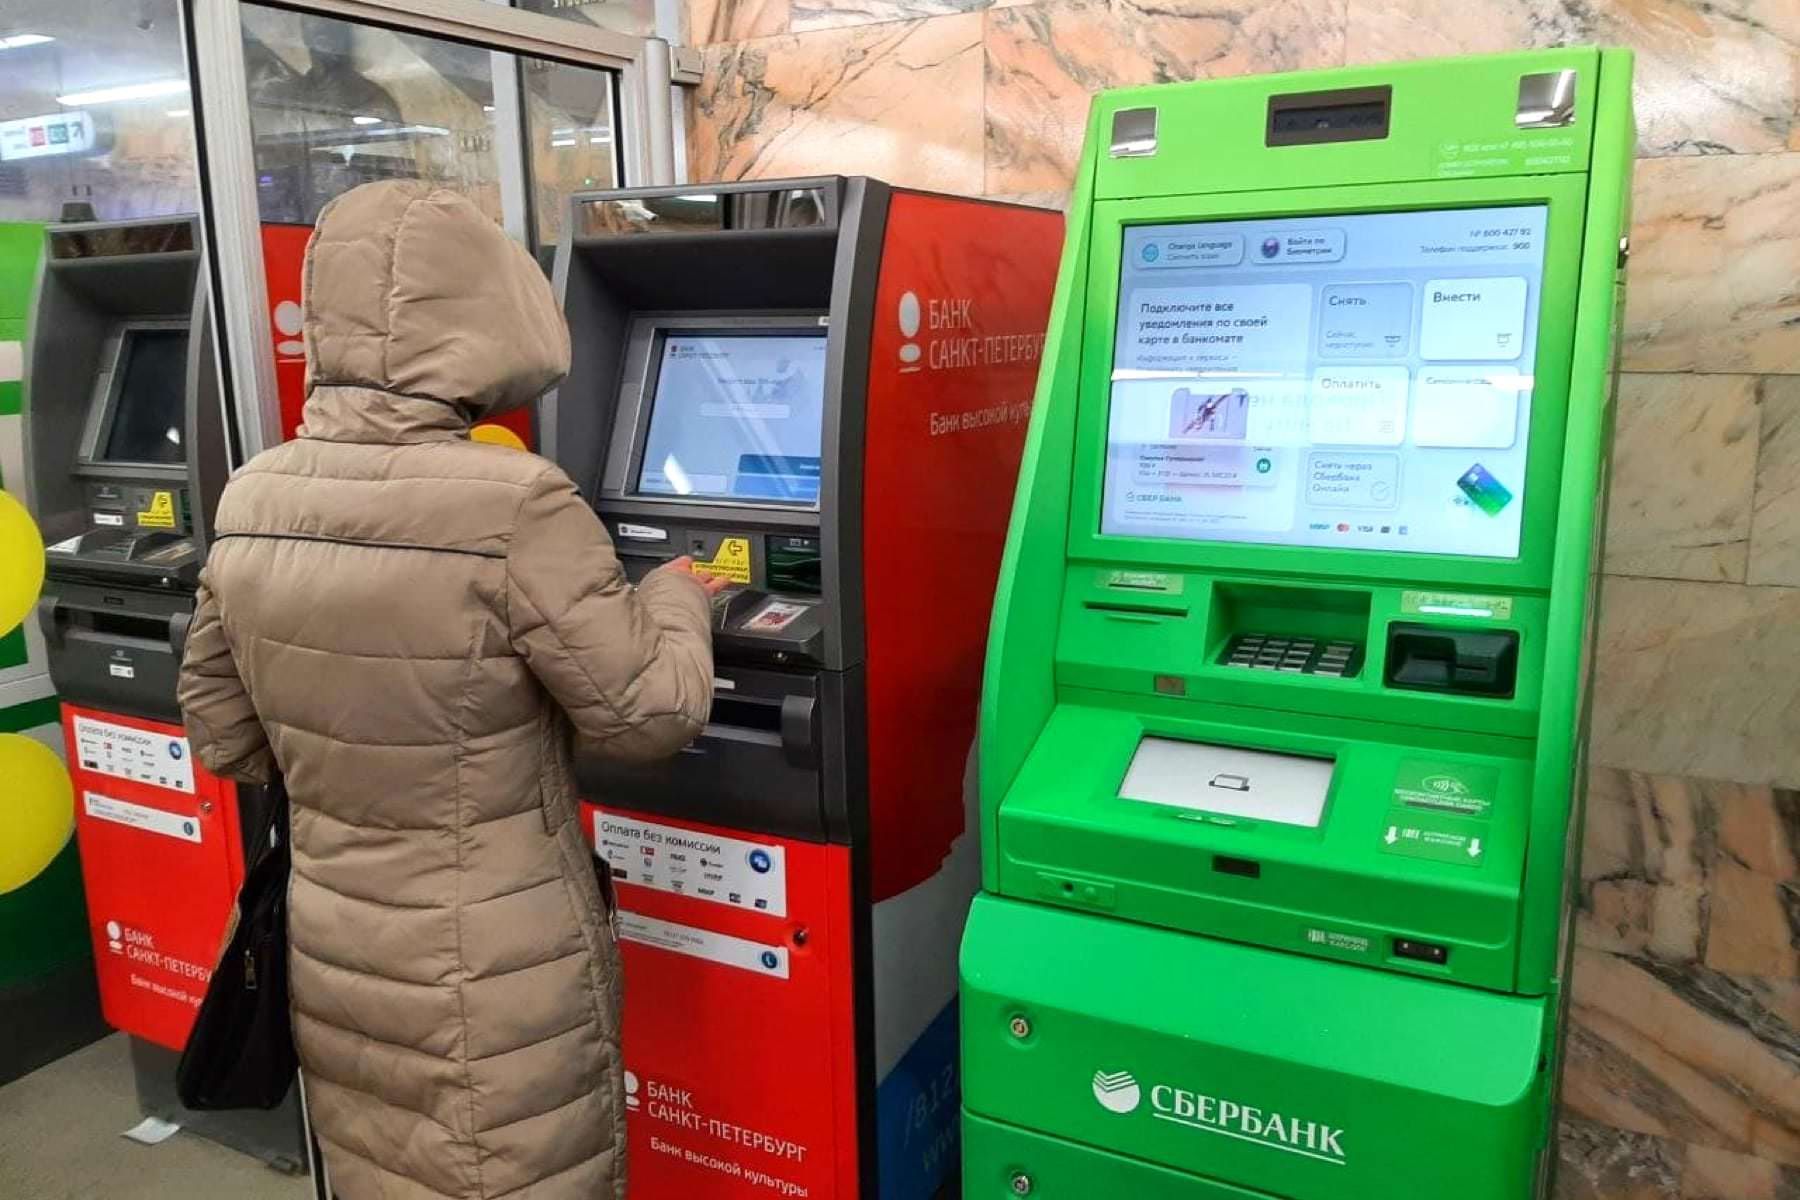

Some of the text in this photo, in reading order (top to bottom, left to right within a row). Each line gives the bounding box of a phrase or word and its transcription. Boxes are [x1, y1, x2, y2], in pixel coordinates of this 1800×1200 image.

[1140, 302, 1234, 315] Подключите все
[1328, 295, 1367, 306] Снять
[1433, 292, 1481, 304] Внести
[929, 299, 972, 329] БАНК
[1139, 315, 1268, 331] уведомления по своей
[1138, 333, 1244, 346] карте в банкомате
[1321, 378, 1382, 390] Оплатить
[930, 412, 960, 436] Банк
[962, 401, 1009, 430] высокой
[601, 820, 721, 855] Оплата без комиссии
[124, 927, 154, 949] БАНК
[126, 944, 212, 983] САНКТ-ПЕТЕРБУ
[647, 1081, 693, 1108] БАНК
[648, 1101, 807, 1163] САНКТ-ПЕТЕРБУРГ
[1151, 1084, 1345, 1157] СБЕРБАНК
[650, 1136, 808, 1197] Банк высокой культуры
